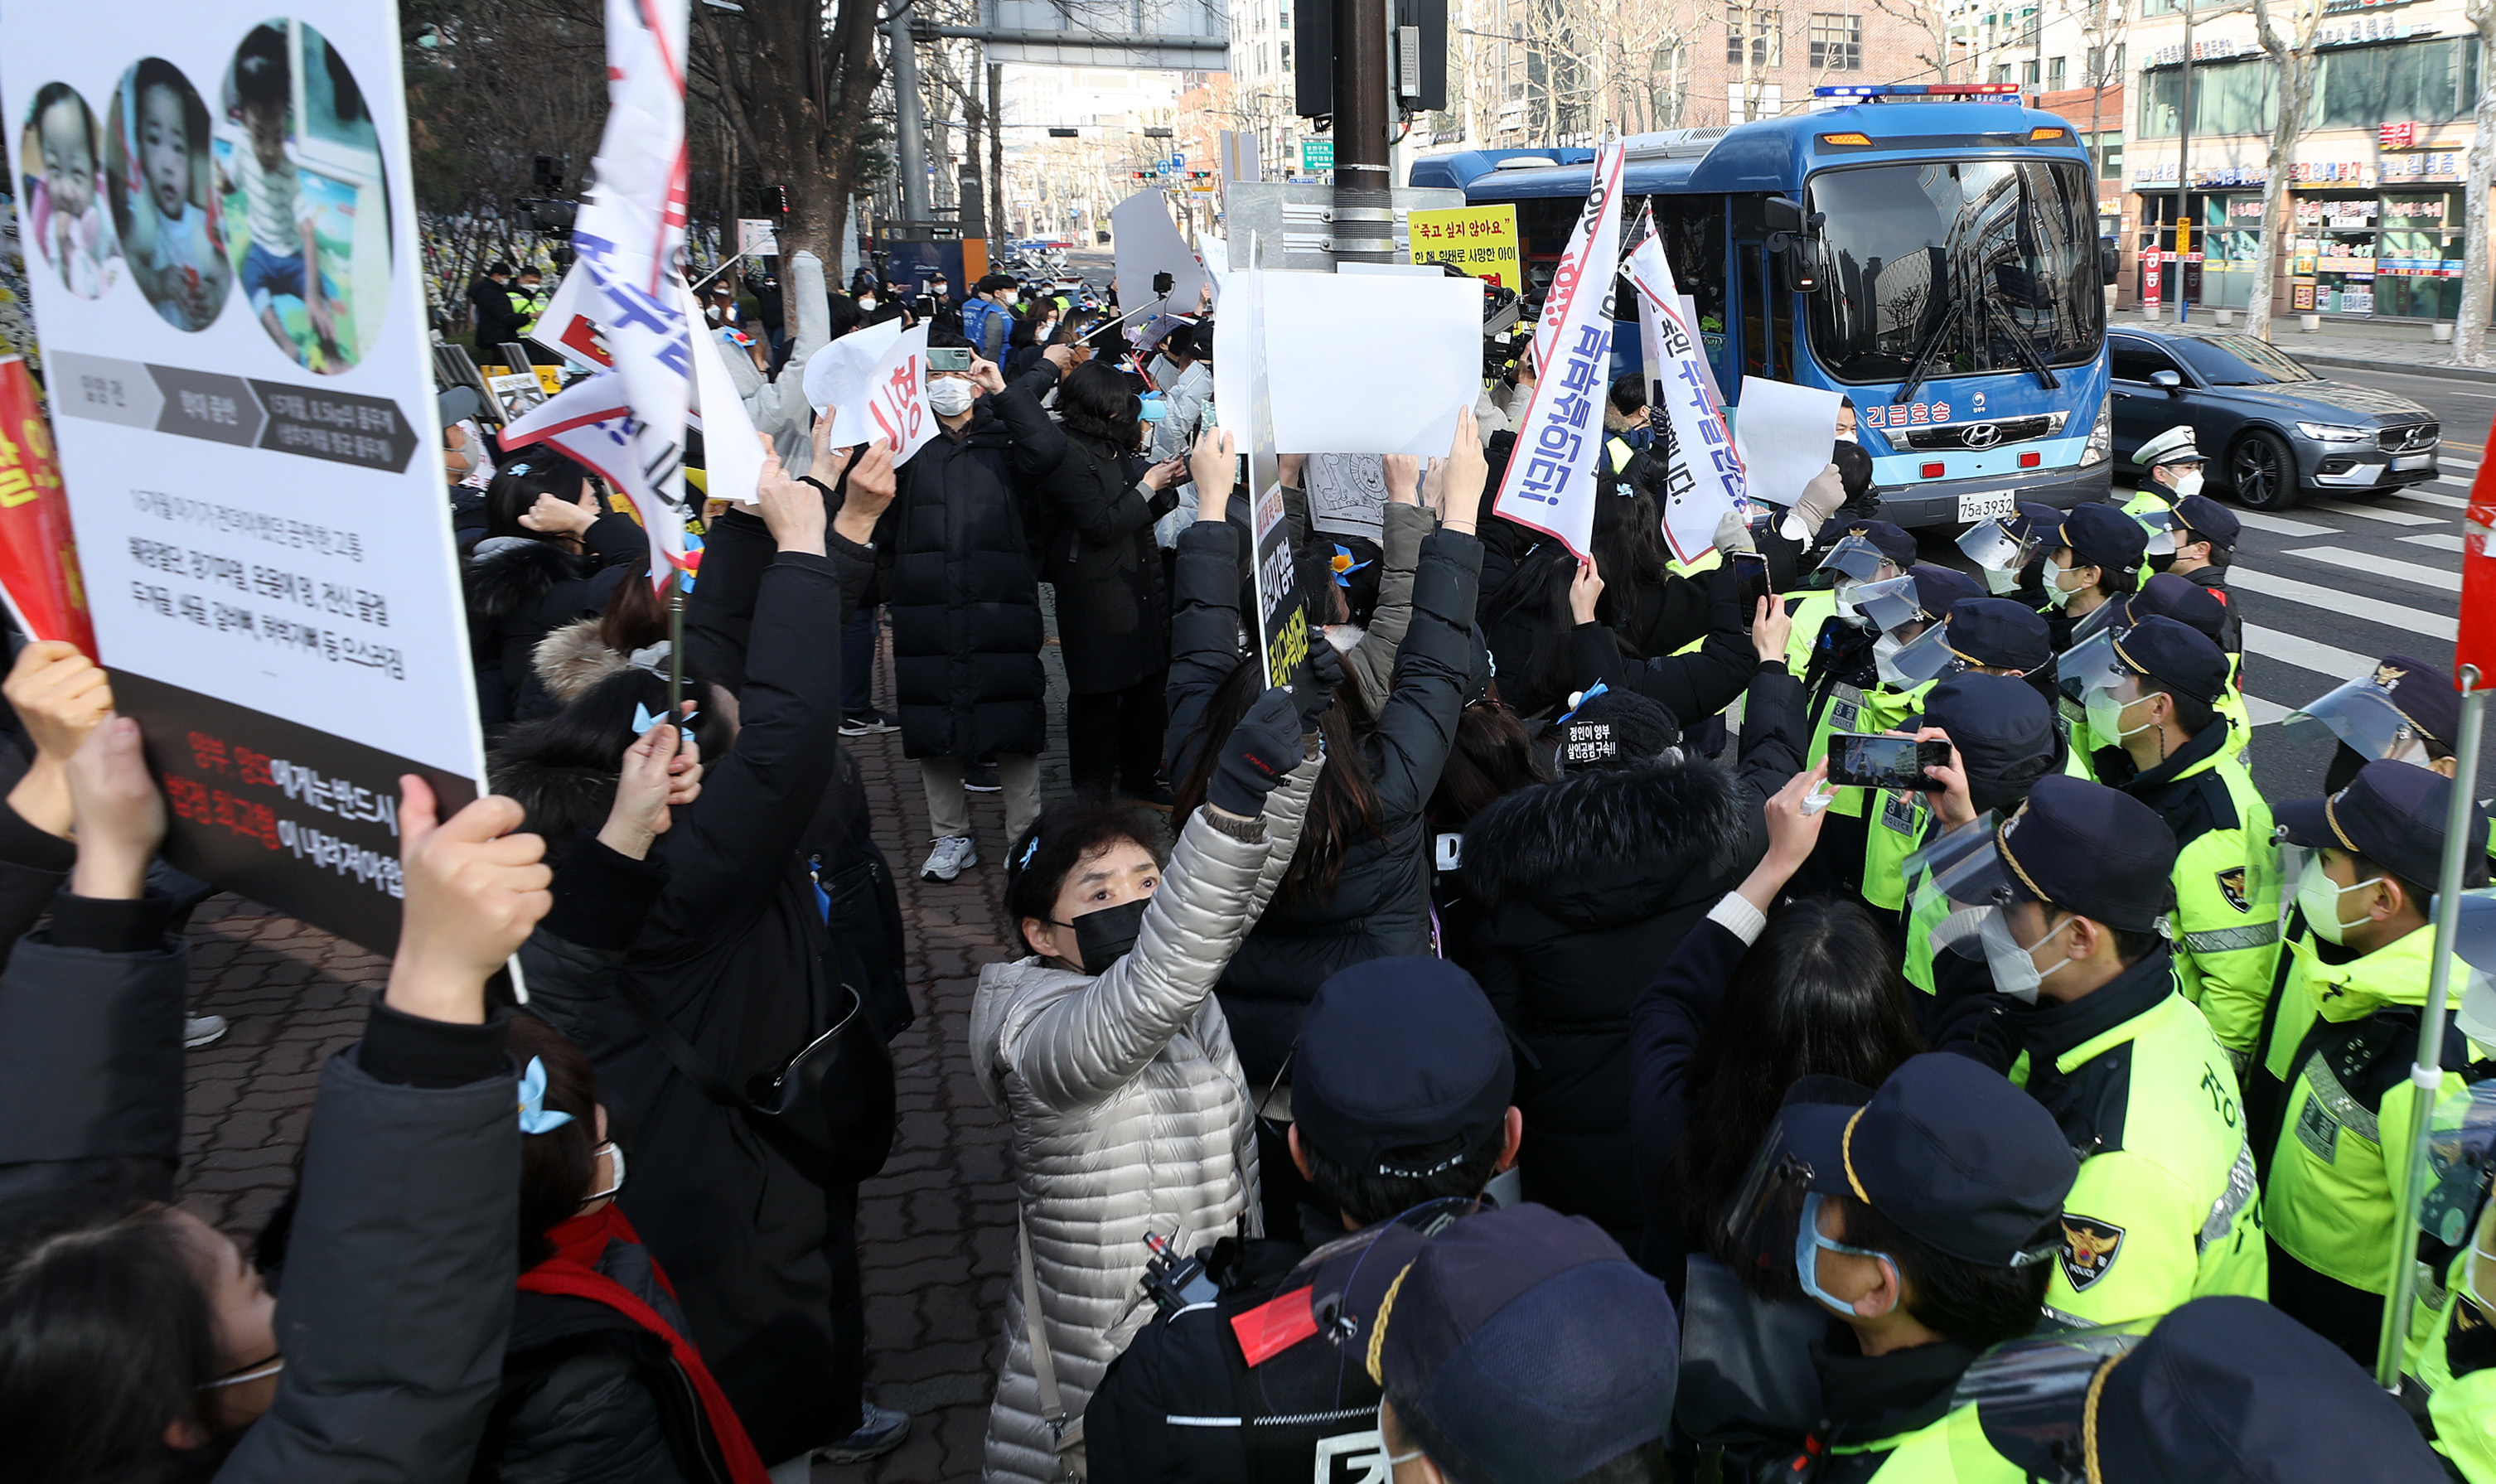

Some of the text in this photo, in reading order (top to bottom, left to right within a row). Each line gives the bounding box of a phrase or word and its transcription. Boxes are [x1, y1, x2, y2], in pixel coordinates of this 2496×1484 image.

[2378, 121, 2414, 147] 녹취
[2409, 152, 2455, 175] 김성종
[1445, 220, 1466, 239] 싶지
[1415, 250, 1424, 264] 한
[1468, 247, 1495, 263] 사망한
[1498, 245, 1516, 262] 아이
[2145, 251, 2161, 288] 공증
[1866, 399, 1952, 428] 긴급호송
[1961, 498, 2013, 519] 75라3932
[356, 589, 390, 628] 골절
[323, 629, 340, 662] 등
[1569, 723, 1610, 742] 정인이 양부
[1831, 716, 1854, 729] POLICE
[1567, 741, 1616, 760] 살인공범 구속!!
[1884, 815, 1911, 833] POLICE
[1379, 1153, 1463, 1177] POLICE
